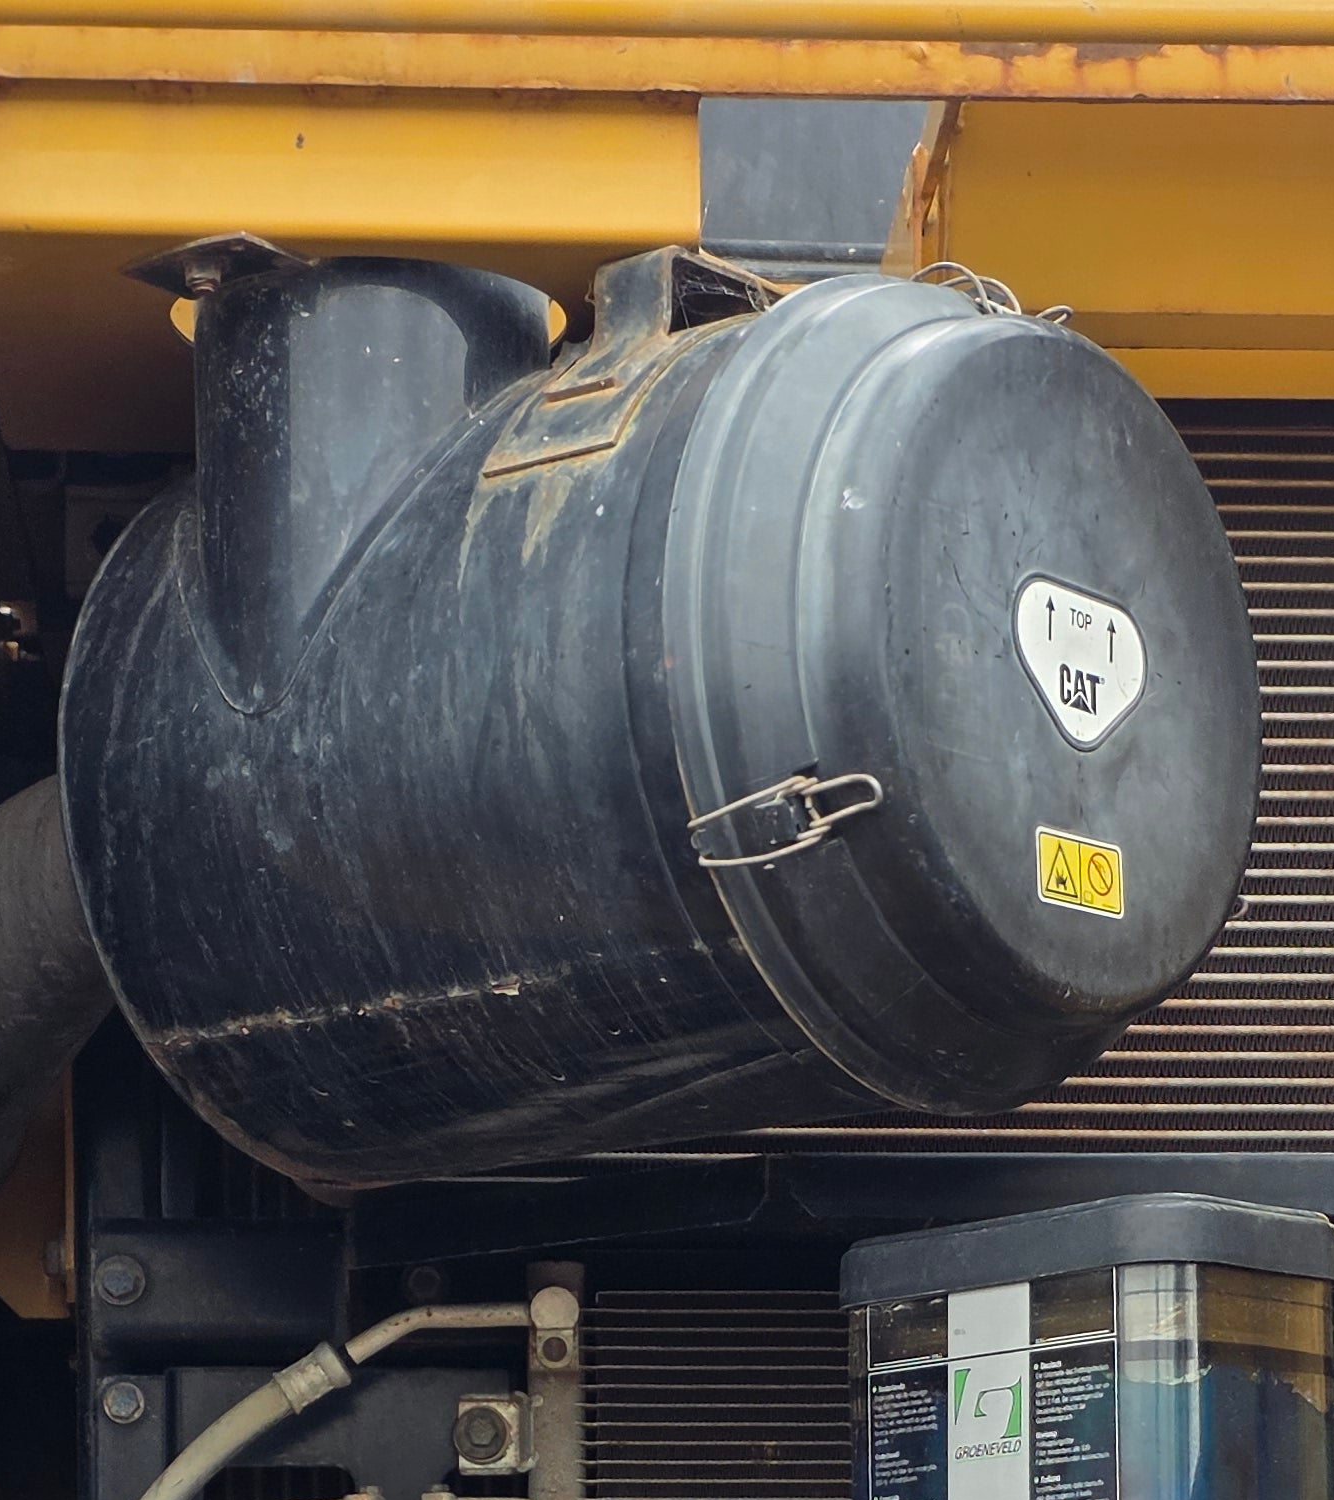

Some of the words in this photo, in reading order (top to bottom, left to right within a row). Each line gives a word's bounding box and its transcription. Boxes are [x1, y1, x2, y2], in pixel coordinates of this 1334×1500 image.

[1069, 607, 1092, 630] TOP
[1059, 663, 1100, 716] CAT
[954, 1439, 1022, 1460] GROENEVELD
